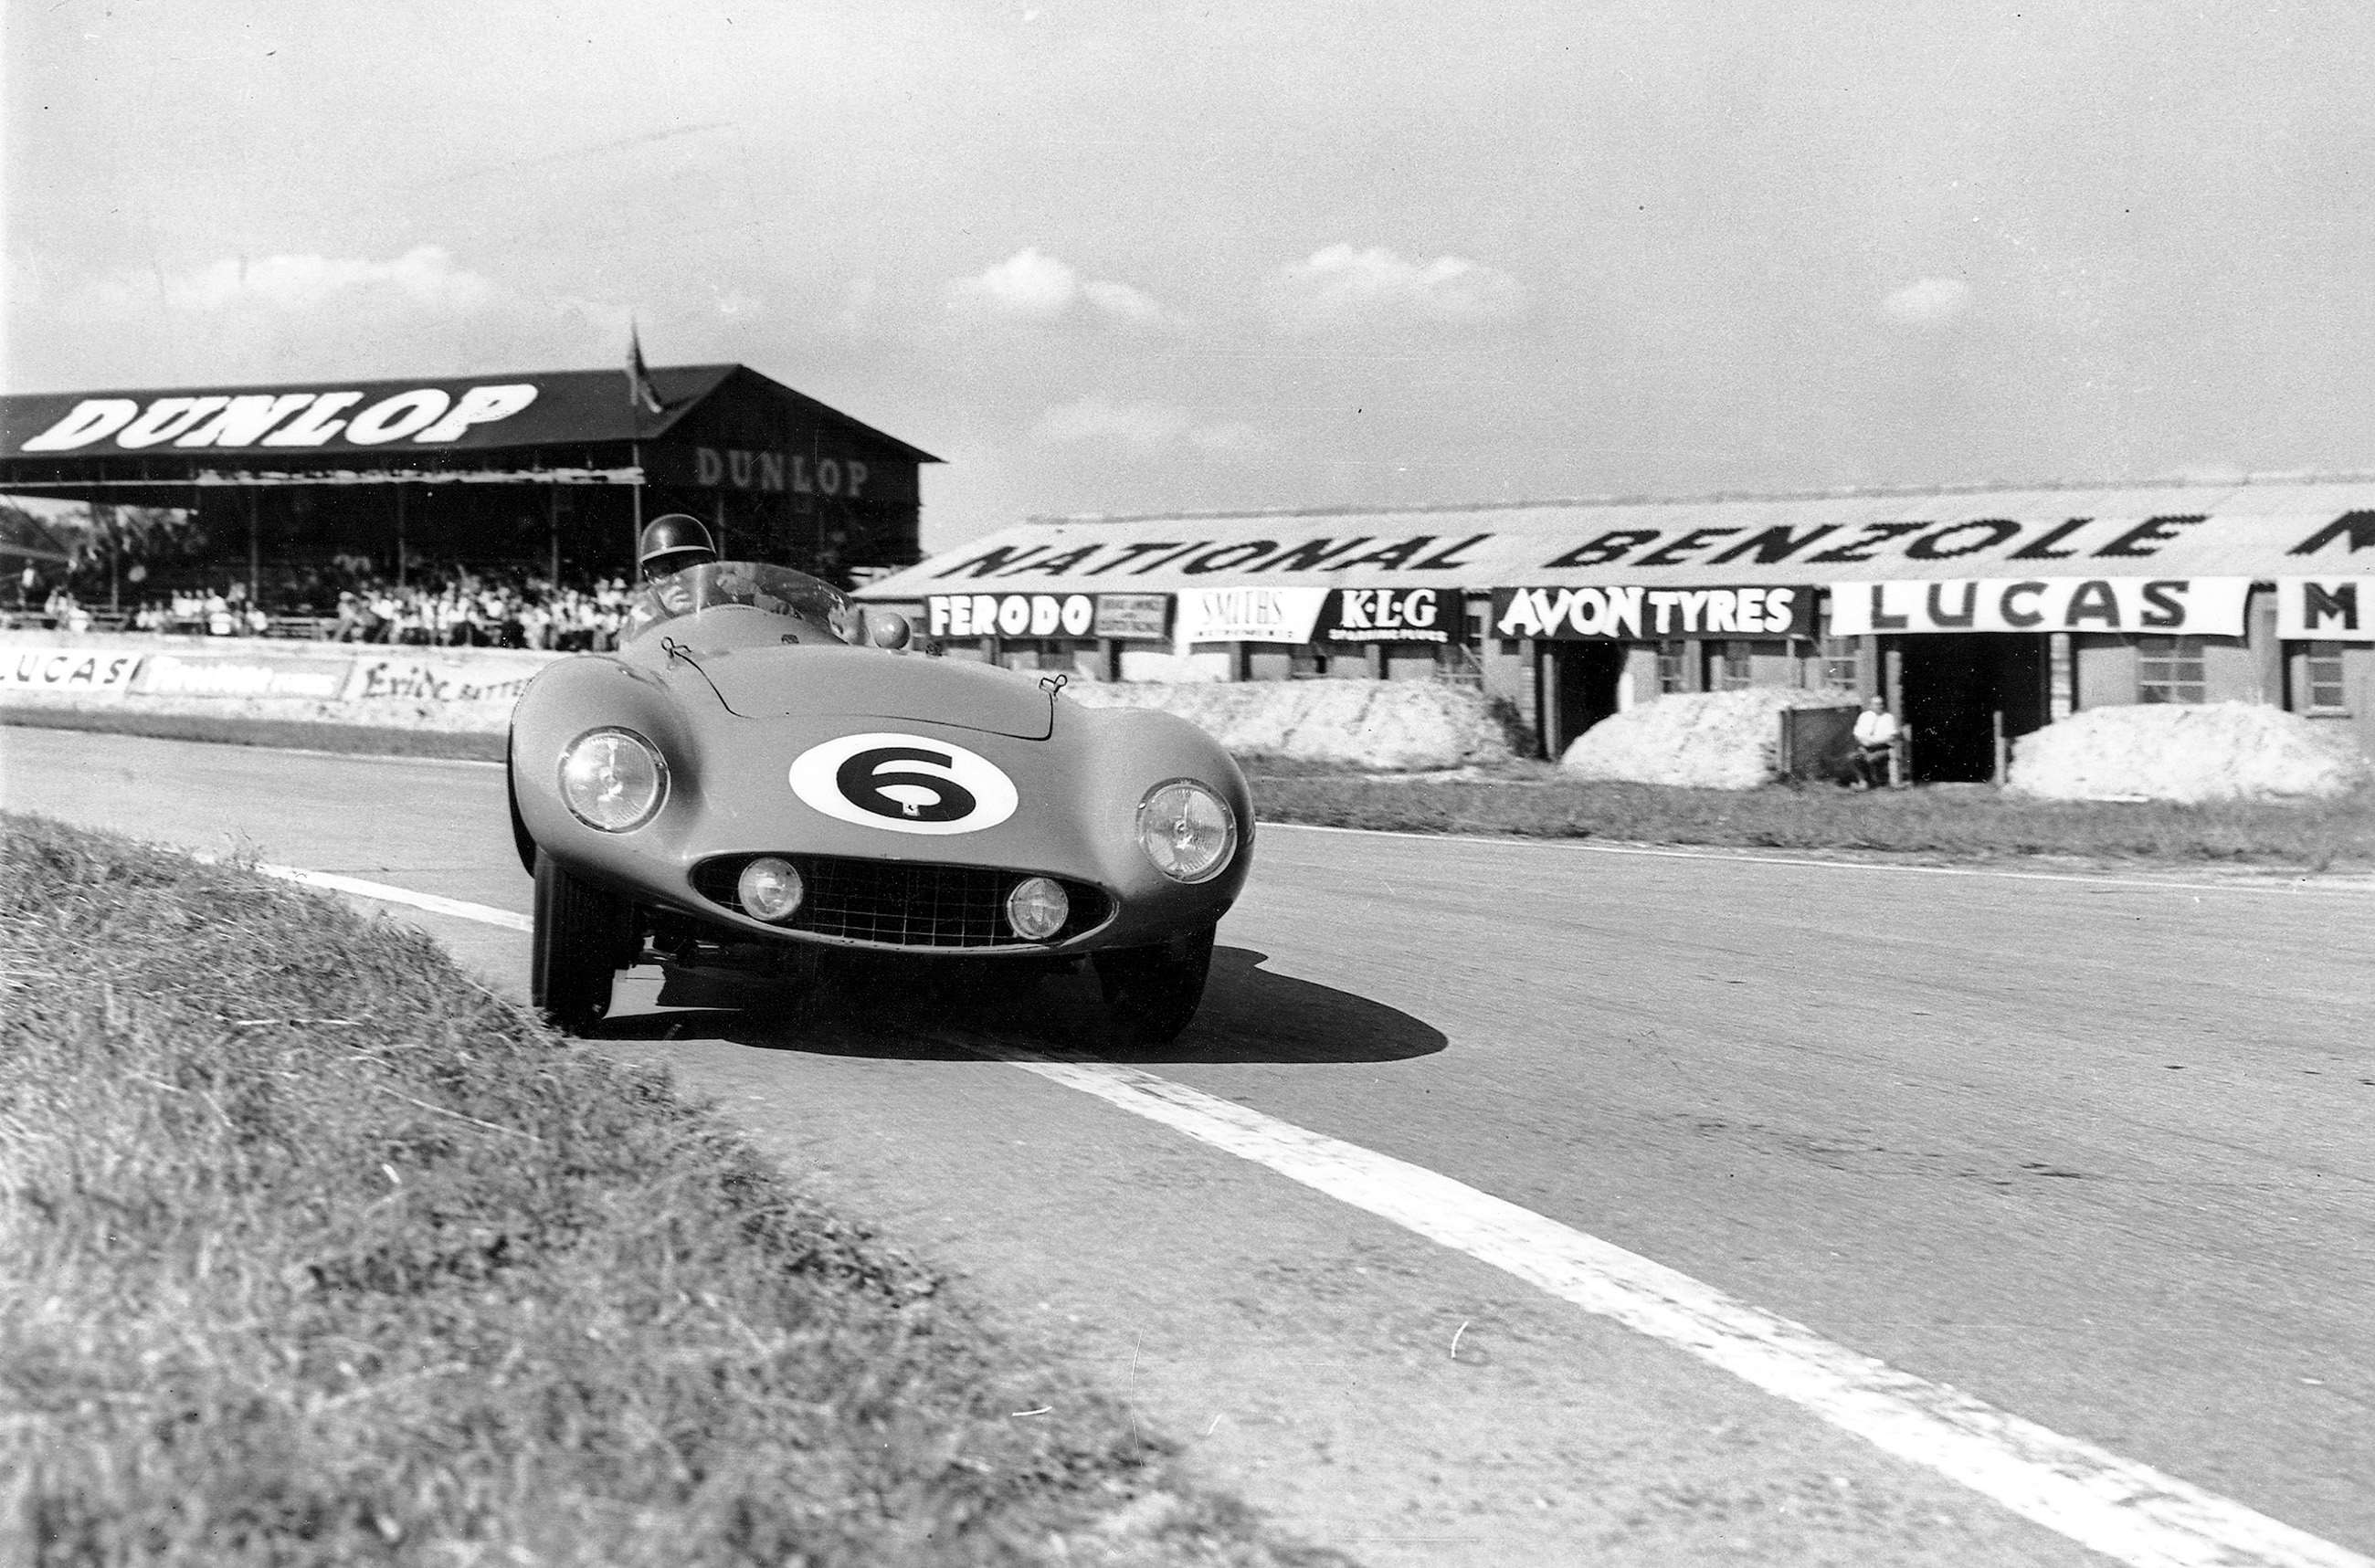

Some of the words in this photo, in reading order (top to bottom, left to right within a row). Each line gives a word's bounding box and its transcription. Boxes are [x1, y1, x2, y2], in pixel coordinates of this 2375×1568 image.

[21, 384, 538, 451] DUNLOP
[697, 447, 868, 497] DUNLOP
[930, 532, 1497, 578] NATIONAL
[1538, 514, 2212, 567] BENZOLE
[928, 595, 1093, 637] FERODO
[1497, 586, 1644, 639] AVON
[1648, 587, 1796, 634] TYRES
[1871, 580, 2190, 629] LUCAS
[836, 747, 976, 822] 6
